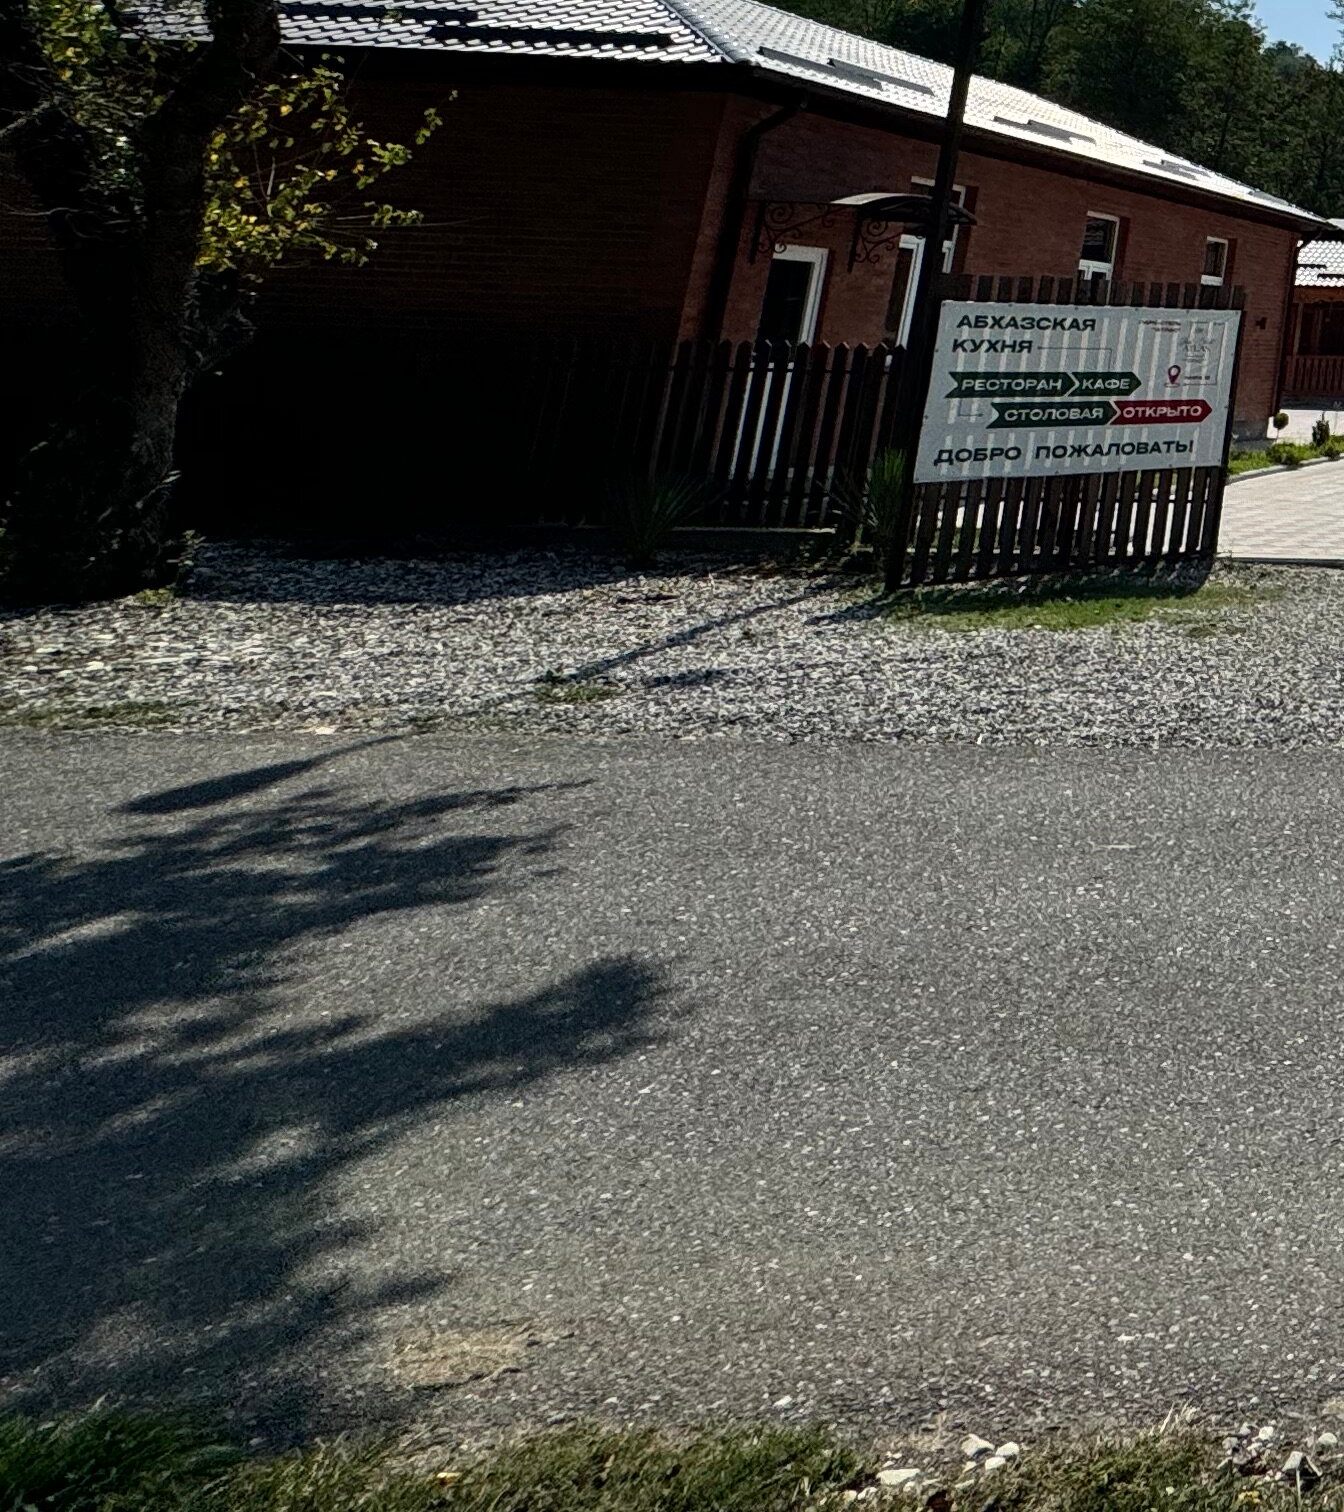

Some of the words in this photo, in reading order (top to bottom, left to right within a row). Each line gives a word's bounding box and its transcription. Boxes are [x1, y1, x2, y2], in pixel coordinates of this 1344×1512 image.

[956, 315, 1096, 332] АБХАЗСКАЯ
[951, 338, 1033, 354] КУХНЯ
[961, 378, 1063, 392] РЕСТОРАН
[1081, 377, 1131, 391] КАФЕ
[1004, 406, 1104, 421] СТОЛОВАЯ
[1122, 405, 1203, 419] ОТКРЫТО
[934, 446, 1022, 466] ДОБРО
[1035, 440, 1194, 460] ПОЖАЛОВАТЬ!
